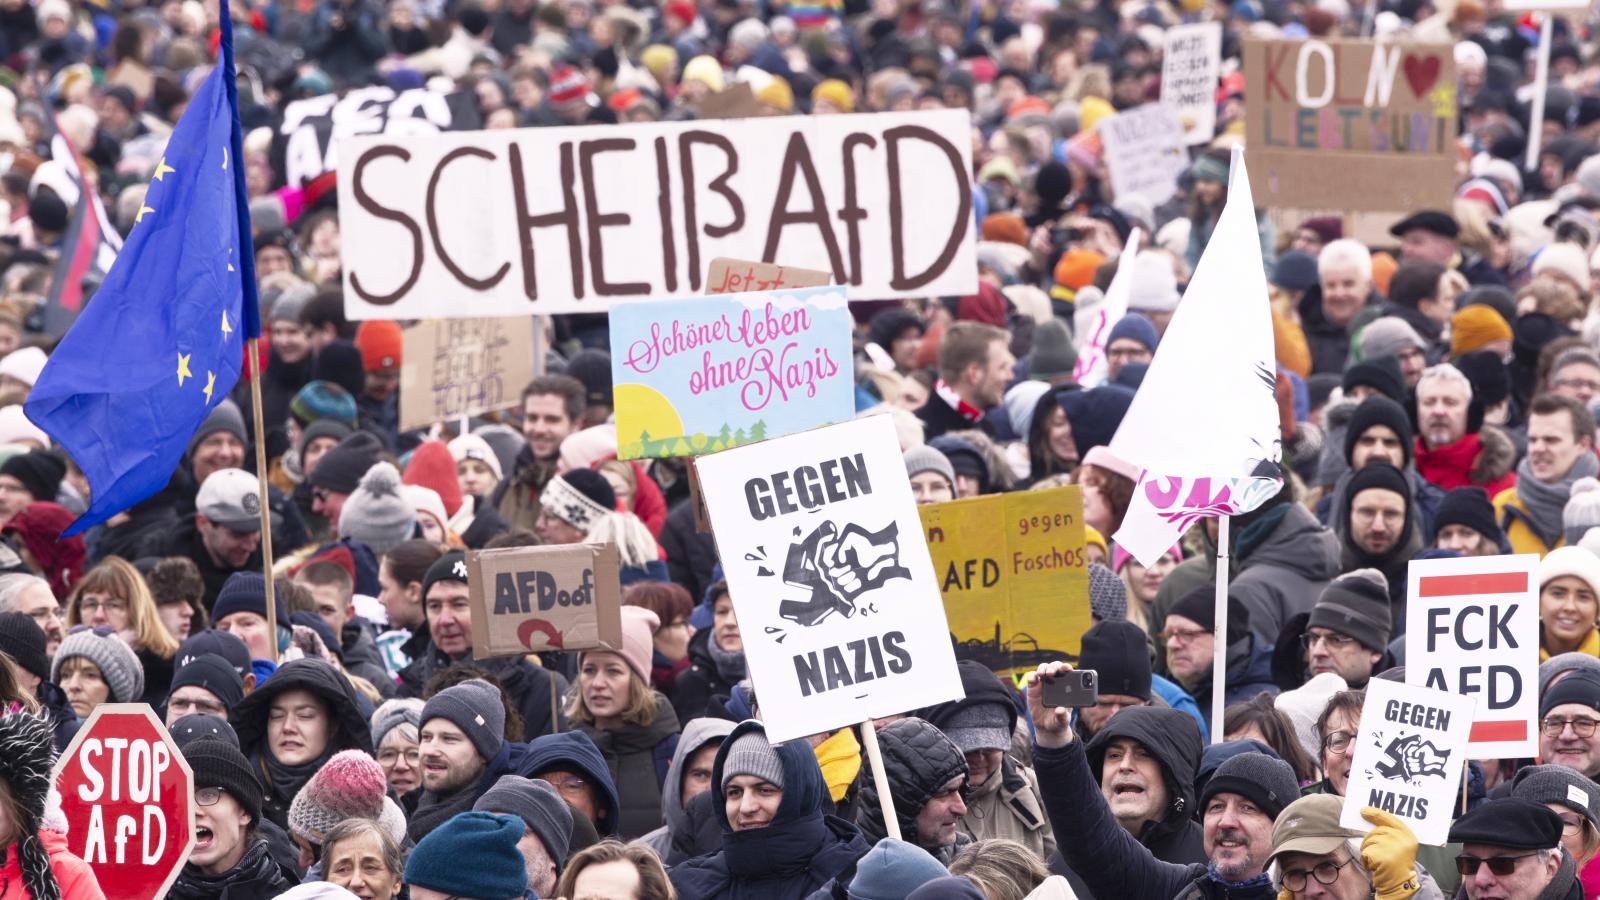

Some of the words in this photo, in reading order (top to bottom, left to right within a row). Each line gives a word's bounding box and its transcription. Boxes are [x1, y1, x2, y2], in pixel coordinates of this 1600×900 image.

[763, 125, 971, 293] AfD
[623, 314, 741, 373] Schöner
[738, 302, 812, 347] leben
[689, 350, 747, 396] ohne
[741, 342, 838, 411] Nazis
[744, 453, 873, 521] GEGEN
[1019, 513, 1073, 536] gegen
[942, 558, 1000, 593] AFD
[1013, 546, 1085, 575] Faschos
[1427, 604, 1519, 652] FCK
[793, 630, 913, 697] NAZIS
[1384, 699, 1451, 732] GEGEN
[78, 737, 170, 803] STOP
[83, 804, 167, 866] AfD
[1368, 788, 1429, 820] NAZIS
